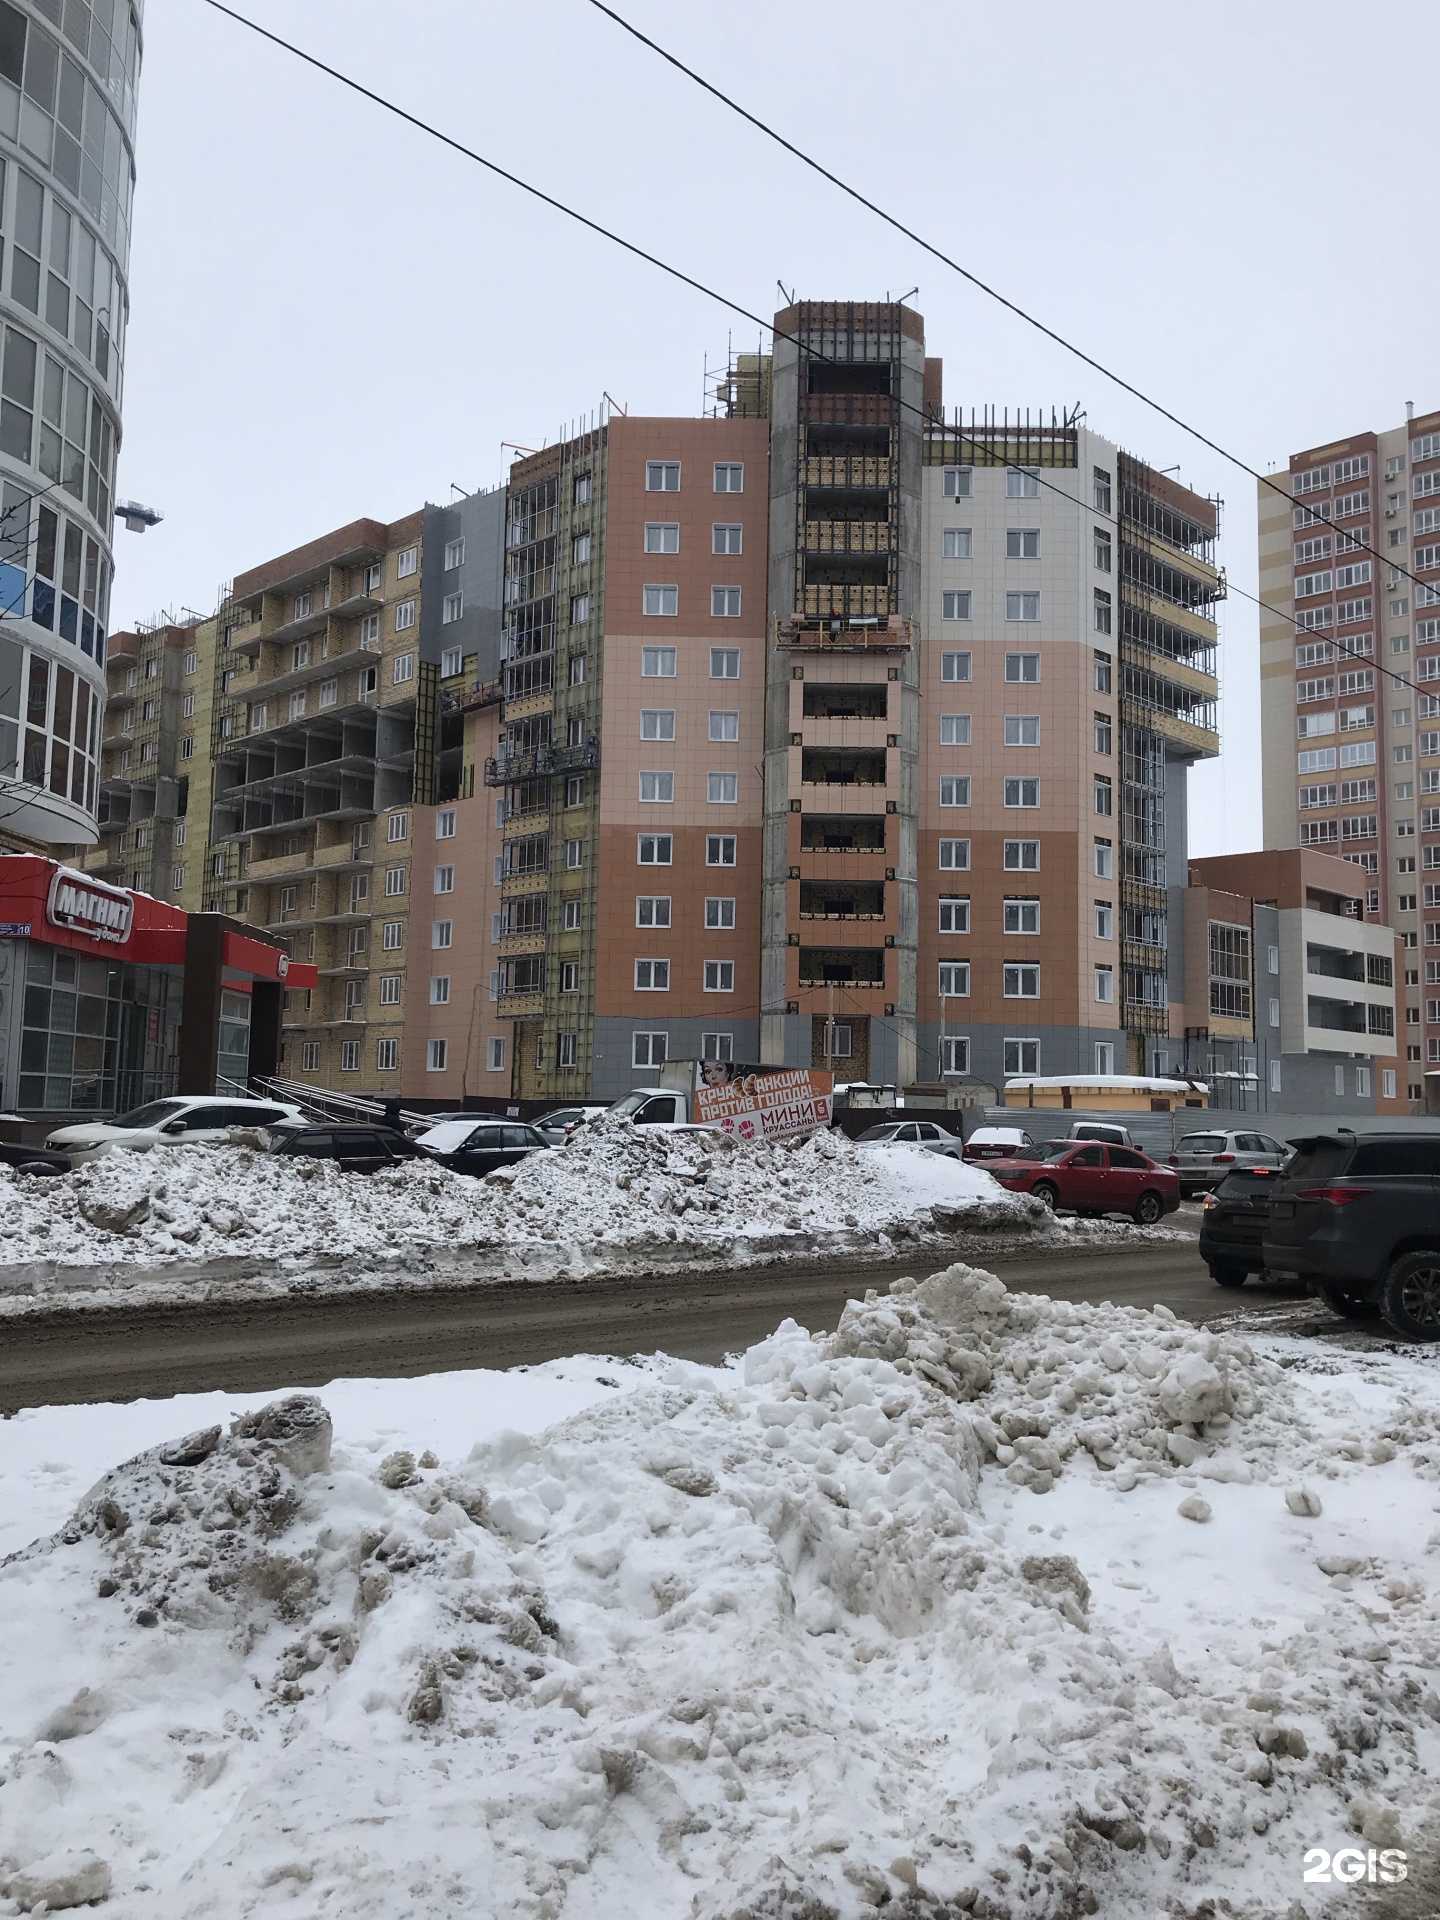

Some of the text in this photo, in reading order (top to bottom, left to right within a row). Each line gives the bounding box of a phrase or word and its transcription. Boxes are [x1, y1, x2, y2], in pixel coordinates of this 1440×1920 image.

[56, 885, 129, 930] МАГНИТ
[701, 1085, 813, 1120] ПРОТИВ ГОЛОДА!
[760, 1102, 813, 1127] МИНИ
[763, 1117, 815, 1135] КРУАССАНЫ
